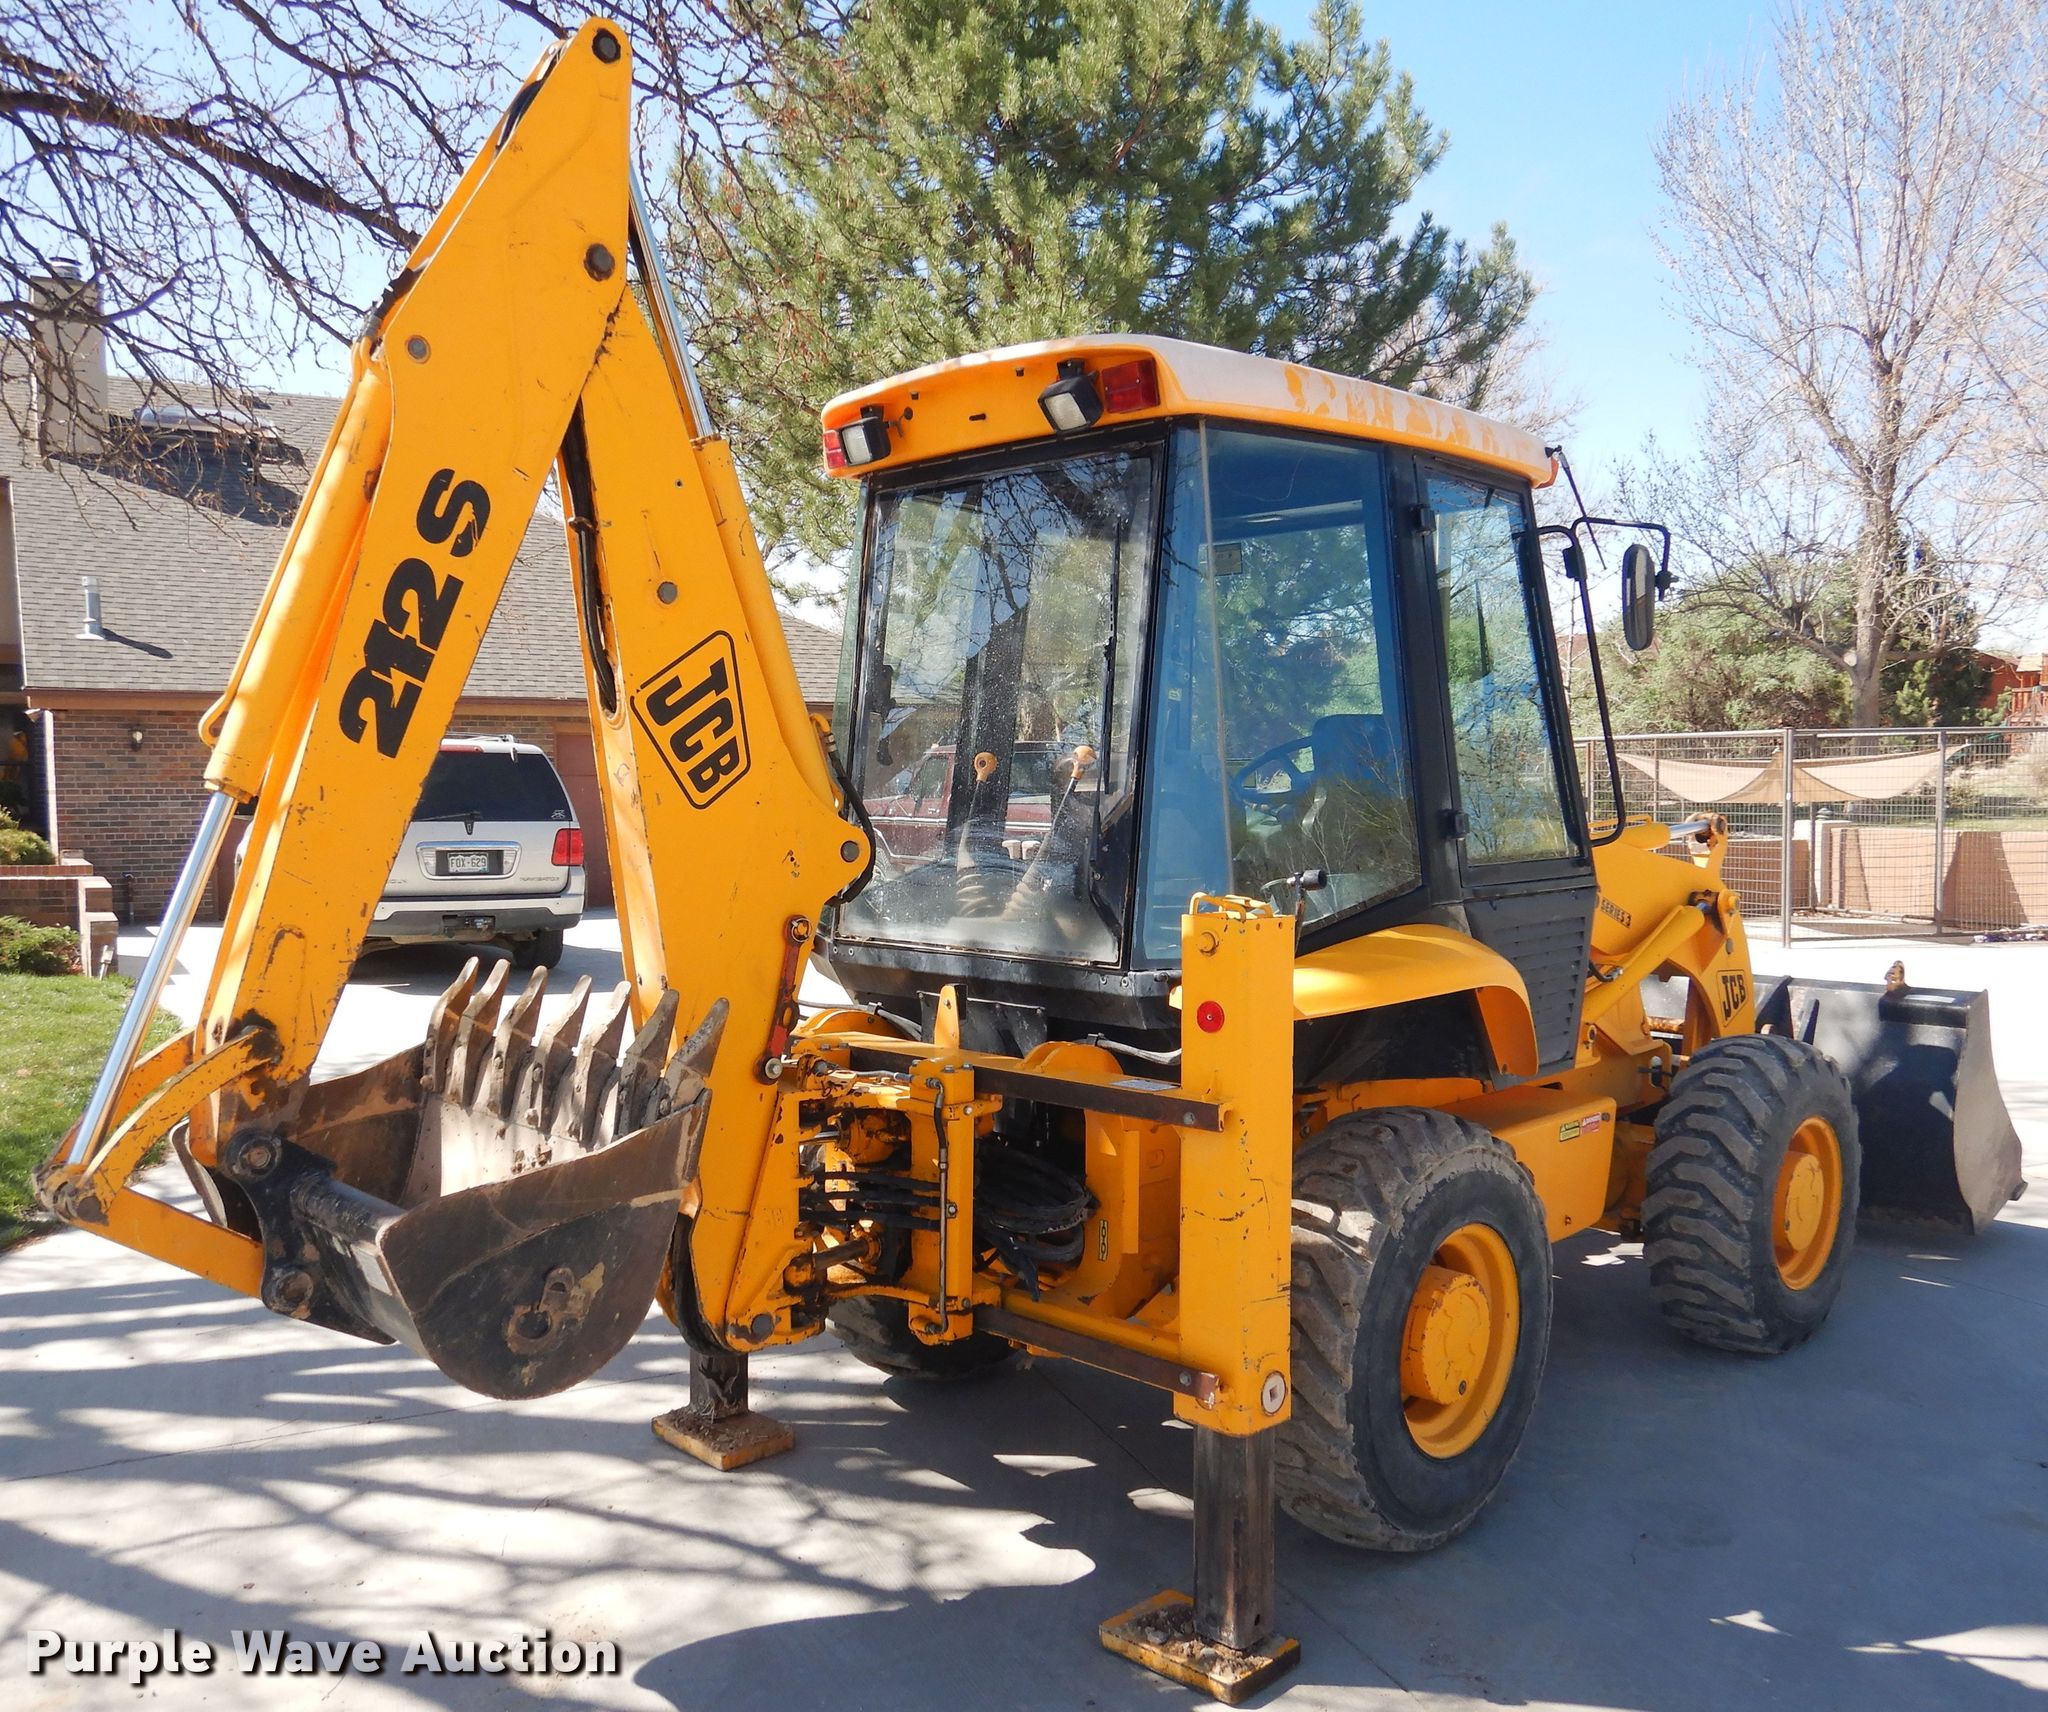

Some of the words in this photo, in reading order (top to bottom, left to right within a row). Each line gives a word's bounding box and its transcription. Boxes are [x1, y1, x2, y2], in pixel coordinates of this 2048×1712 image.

[339, 557, 464, 759] 212
[416, 468, 491, 558] S
[646, 657, 740, 793] JCB
[1721, 974, 1746, 1021] JCB
